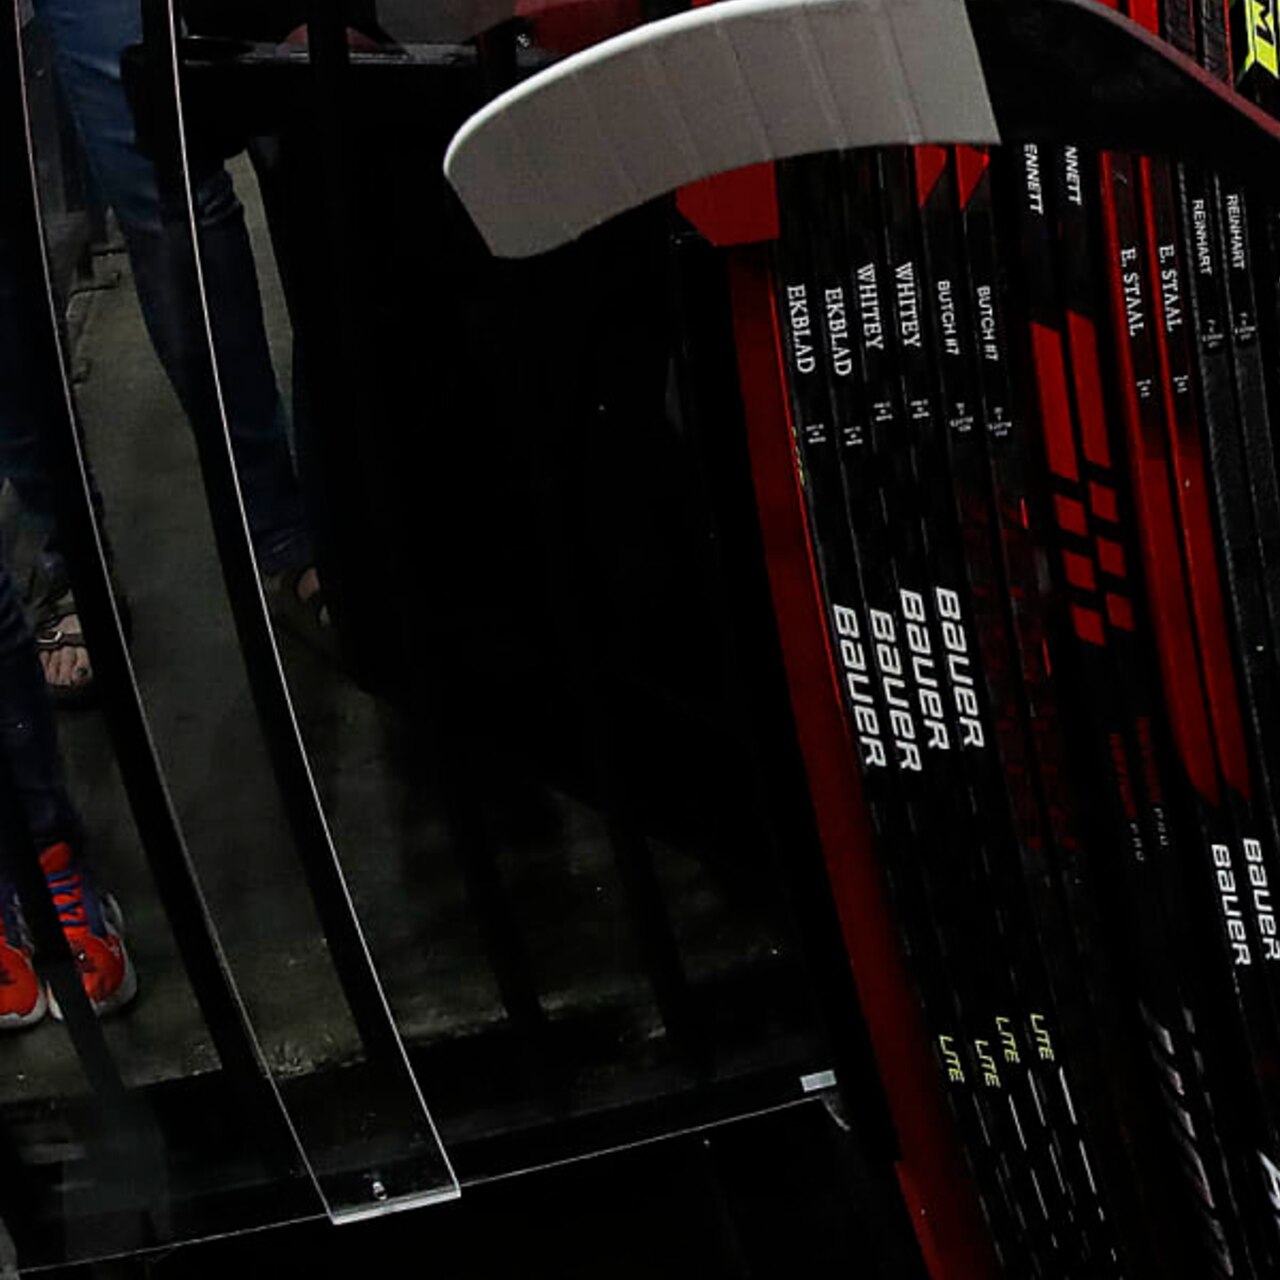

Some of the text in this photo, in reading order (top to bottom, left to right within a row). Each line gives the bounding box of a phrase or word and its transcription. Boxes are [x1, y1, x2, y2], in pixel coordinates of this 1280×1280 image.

[1192, 197, 1213, 276] REINHART
[1225, 193, 1246, 270] REINHART
[787, 284, 816, 374] EKBLAD
[825, 286, 853, 377] EKBLAD
[856, 262, 885, 350] WHITEY
[894, 261, 922, 348] WHITEY
[937, 280, 957, 336] BUTCH
[976, 285, 996, 341] BUTCH
[1122, 271, 1145, 337] STAAL
[1160, 268, 1183, 332] STAAL
[832, 603, 888, 768] BAUER
[869, 607, 923, 772] BAUER
[899, 587, 951, 750] BAUER
[934, 585, 985, 748] BAUER
[1211, 843, 1252, 966] BAUER
